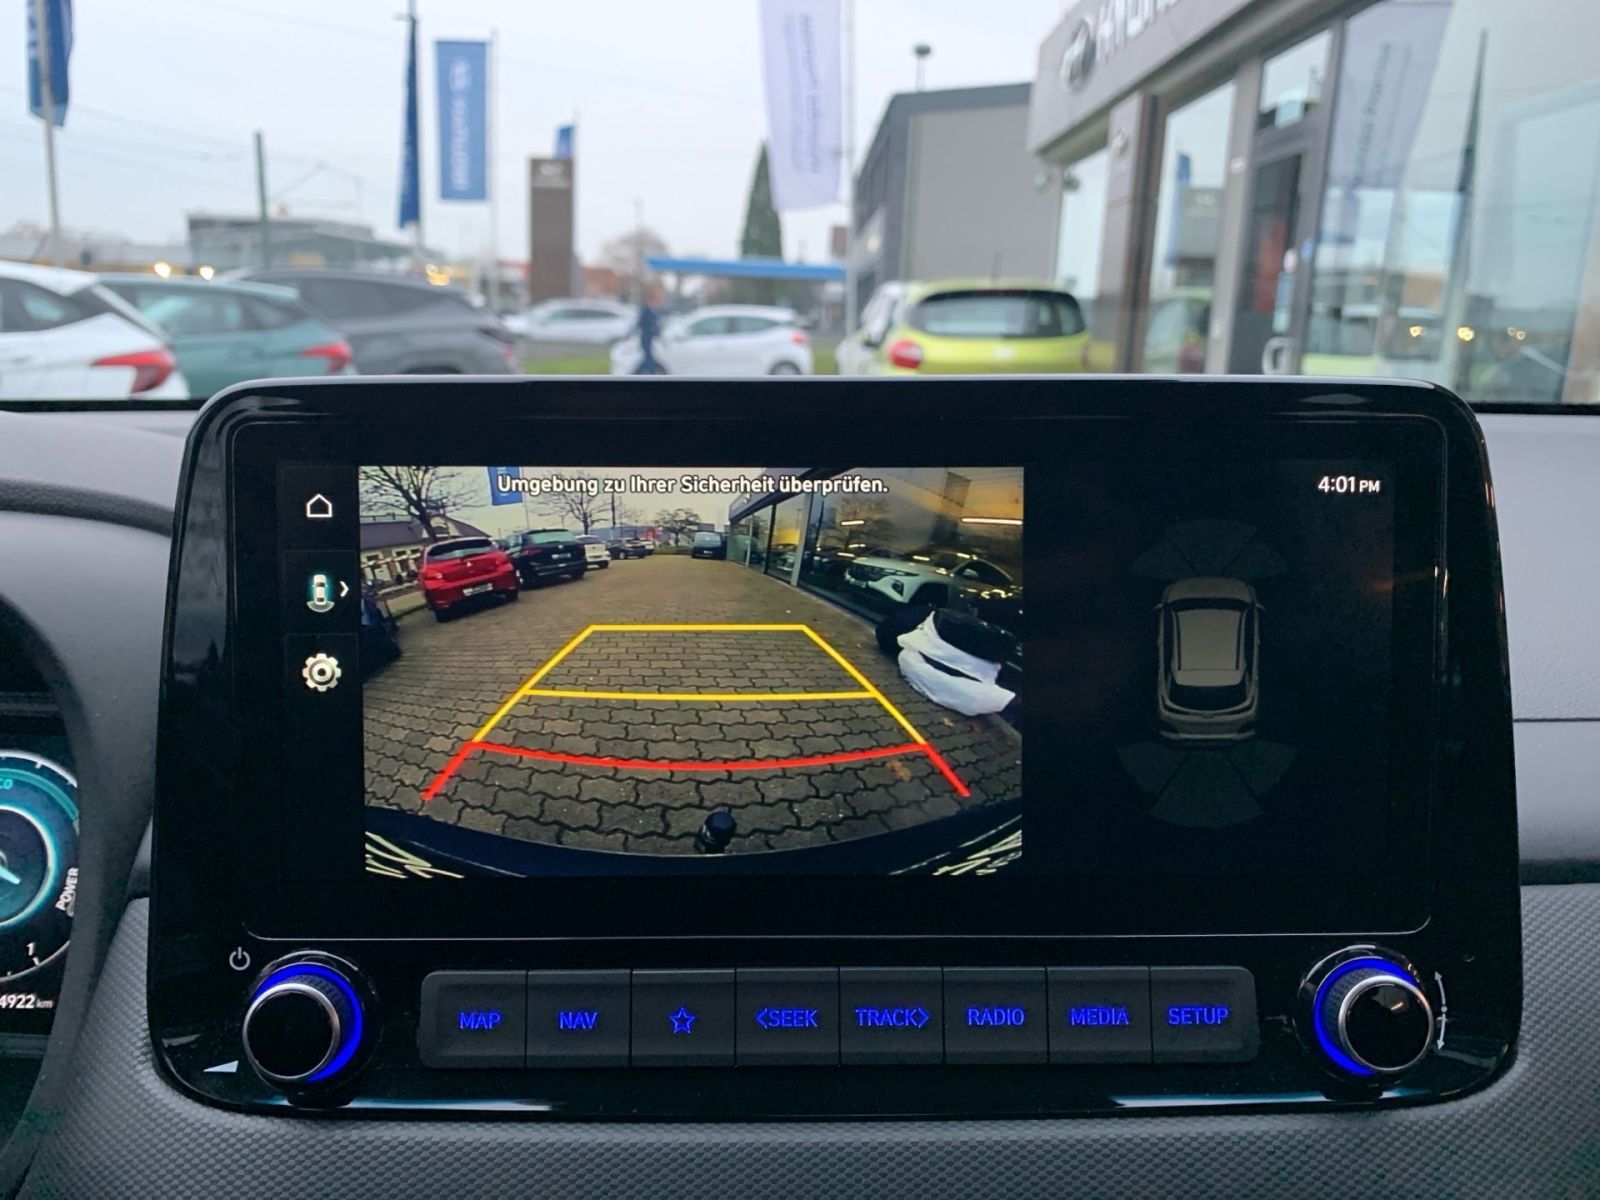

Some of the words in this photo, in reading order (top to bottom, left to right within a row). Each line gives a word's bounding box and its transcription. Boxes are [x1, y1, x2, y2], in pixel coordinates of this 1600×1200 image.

[498, 475, 598, 496] Umgebung
[604, 479, 625, 493] zu
[630, 475, 676, 493] Ihrer
[681, 475, 775, 493] Sicherheit
[779, 475, 889, 496] überprüfen.
[1318, 475, 1356, 493] 4:01
[1359, 480, 1381, 493] PM
[55, 867, 79, 911] POWER
[27, 942, 36, 957] 1
[36, 998, 53, 1009] km
[458, 1011, 502, 1030] MAP
[559, 1011, 598, 1030] NAV
[967, 1007, 1025, 1026] RADIO
[1069, 1006, 1130, 1026] MEDIA
[1167, 1006, 1230, 1026] SETUP
